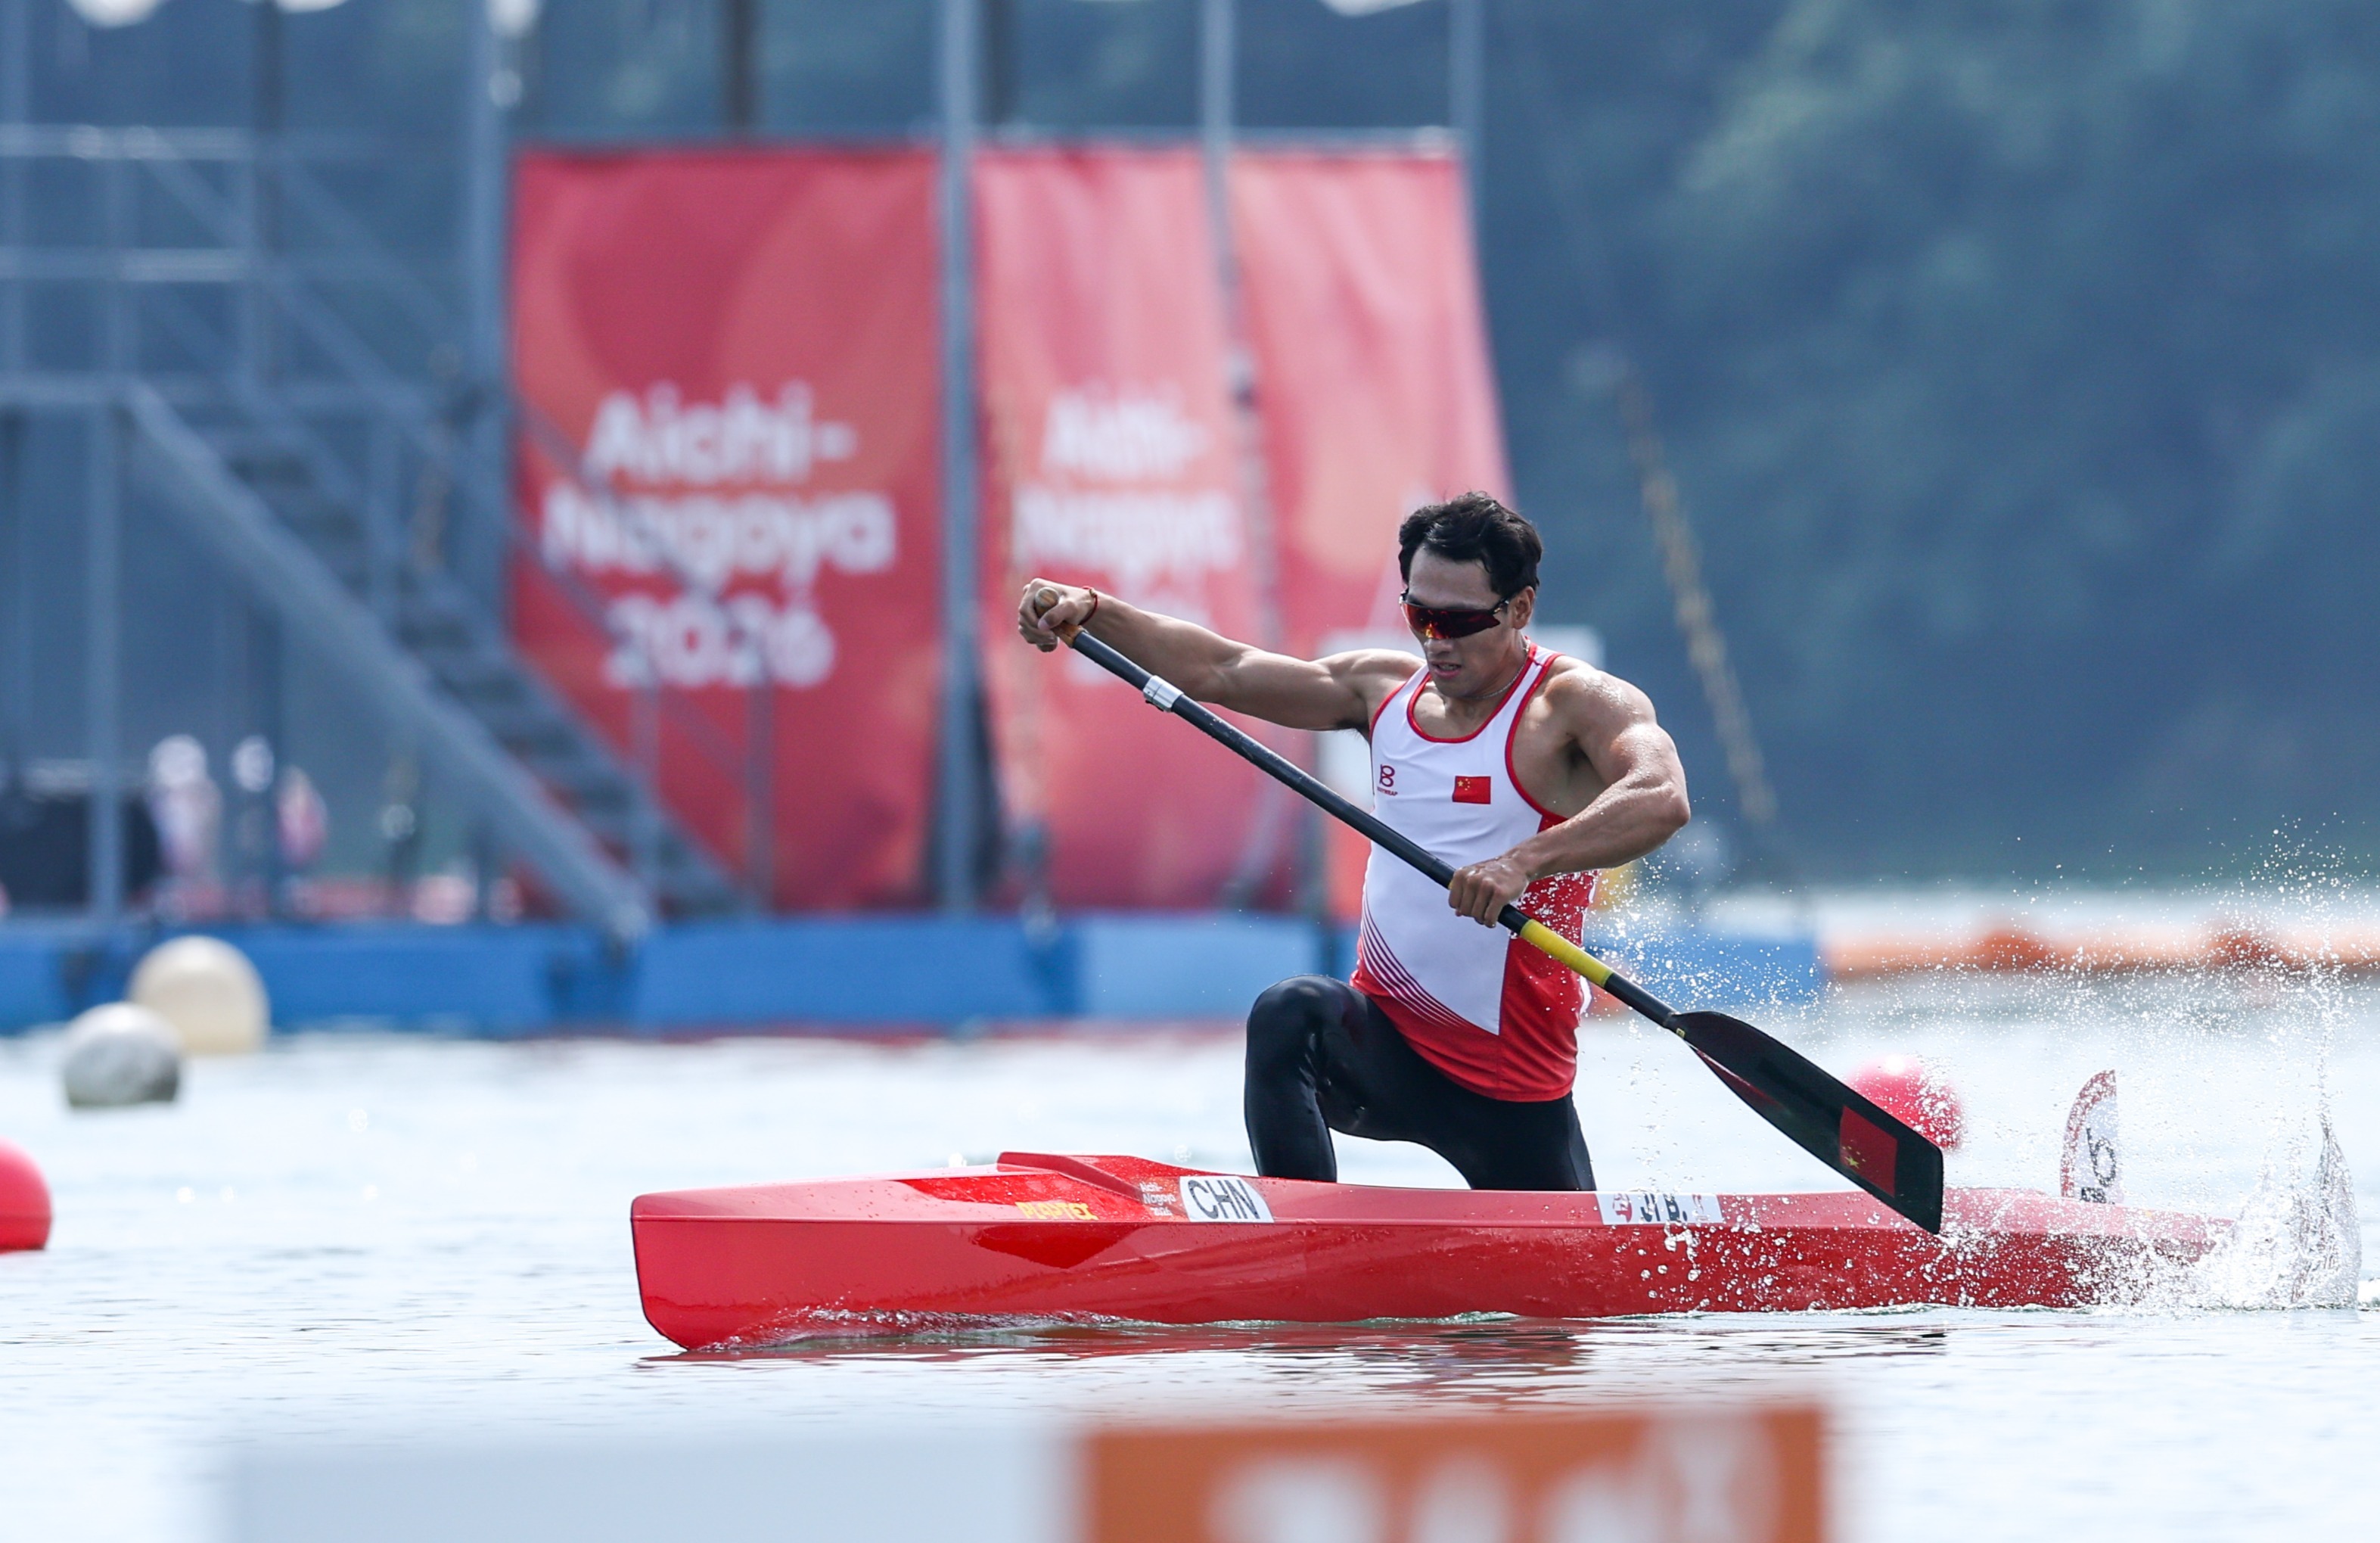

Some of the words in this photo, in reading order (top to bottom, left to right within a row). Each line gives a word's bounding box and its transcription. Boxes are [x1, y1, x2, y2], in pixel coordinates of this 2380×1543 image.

[581, 378, 856, 483] Aichi-
[540, 482, 897, 602] Nagoya
[604, 594, 835, 687] 2026
[1187, 1179, 1261, 1220] CHN
